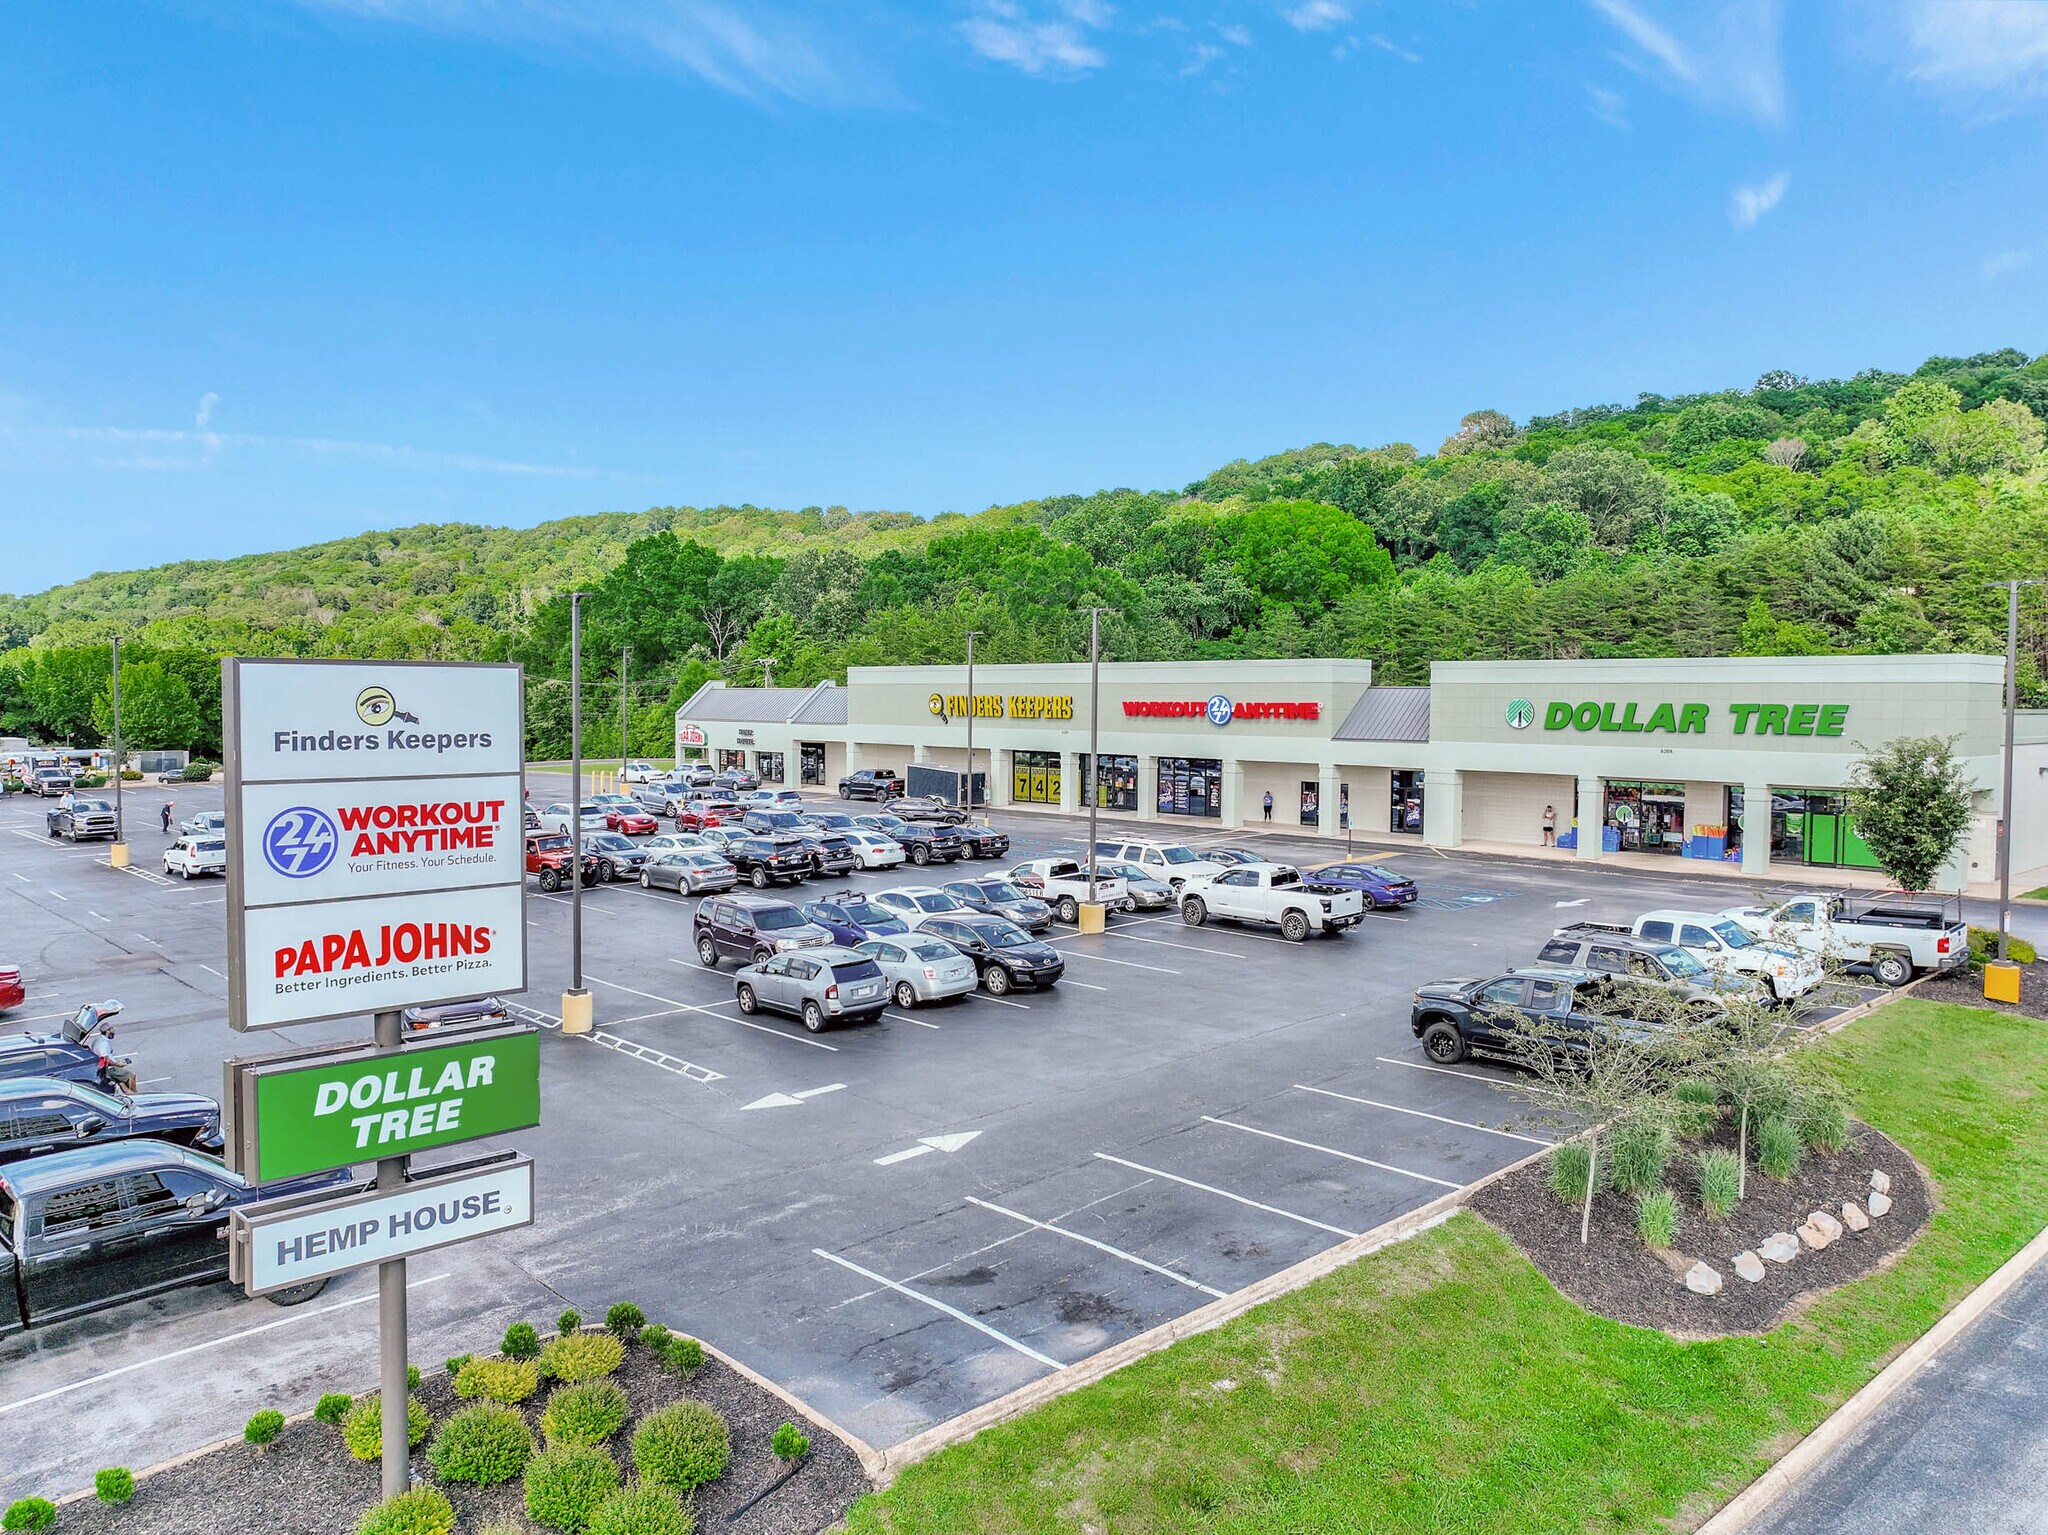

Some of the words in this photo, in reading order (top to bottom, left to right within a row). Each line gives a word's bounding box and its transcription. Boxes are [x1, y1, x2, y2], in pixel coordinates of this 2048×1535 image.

[946, 695, 1004, 717] FINDERS
[1007, 695, 1073, 719] KEEPERS
[1122, 701, 1207, 718] WORKOUT
[1232, 702, 1319, 720] ANYTIME
[1544, 701, 1709, 733] DOLLAR
[1729, 704, 1849, 736] TREE
[274, 730, 380, 752] Finders
[387, 729, 493, 753] Keepers
[337, 800, 505, 831] WORKOUT
[275, 814, 332, 853] 24
[351, 825, 494, 857] ANYTIME
[282, 846, 309, 872] 7
[348, 862, 374, 873] Your
[376, 859, 419, 870] Fitness.
[421, 857, 445, 867] Your
[447, 853, 497, 866] Schedule.
[275, 929, 372, 978] PAPA
[375, 922, 491, 967] JOHNS
[275, 980, 322, 994] Better
[325, 970, 409, 988] Ingredients.
[412, 963, 453, 977] Better
[456, 958, 492, 971] Pizza.
[314, 1055, 496, 1116] DOLLAR
[350, 1097, 463, 1148] TREE
[277, 1219, 380, 1266] HEMP
[389, 1190, 501, 1238] HOUSE
